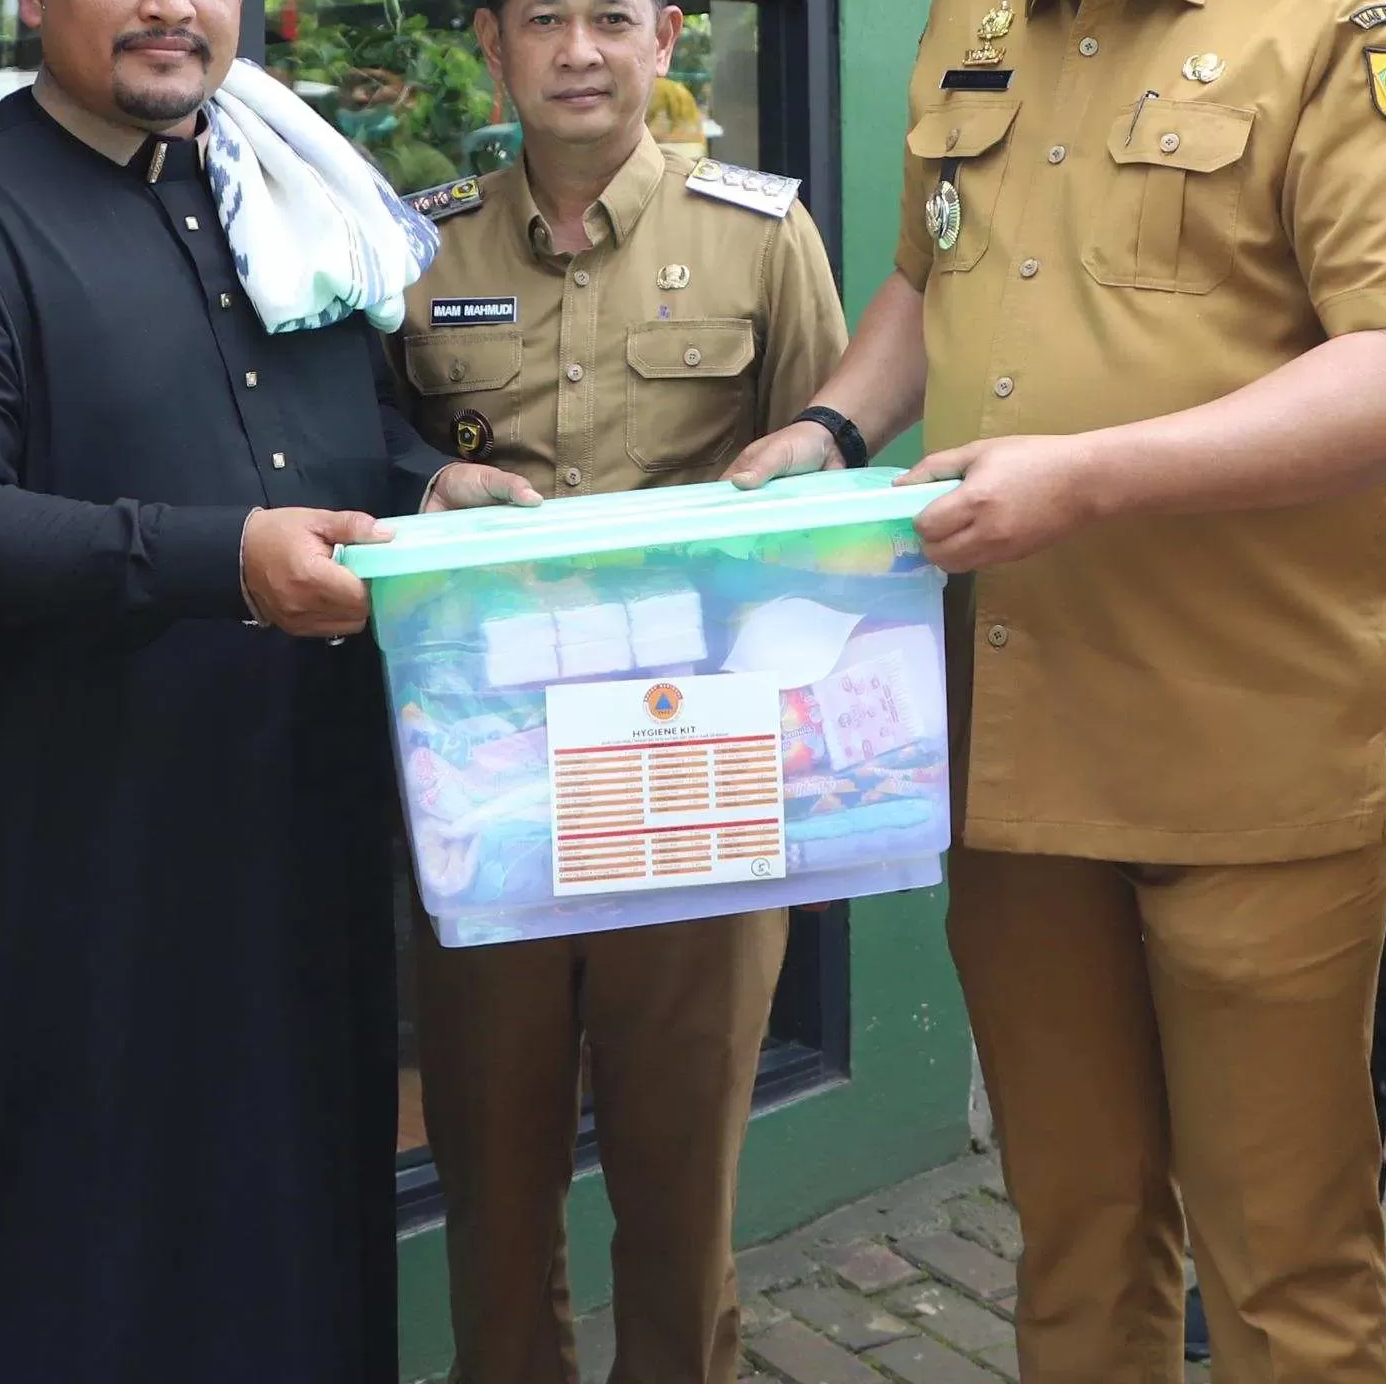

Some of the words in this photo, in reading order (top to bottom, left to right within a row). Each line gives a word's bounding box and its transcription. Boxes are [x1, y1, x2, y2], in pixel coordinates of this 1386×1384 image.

[433, 305, 462, 317] IMAM
[463, 303, 513, 316] MAHMUDI
[632, 727, 678, 737] HYGIENE
[680, 725, 696, 734] KIT
